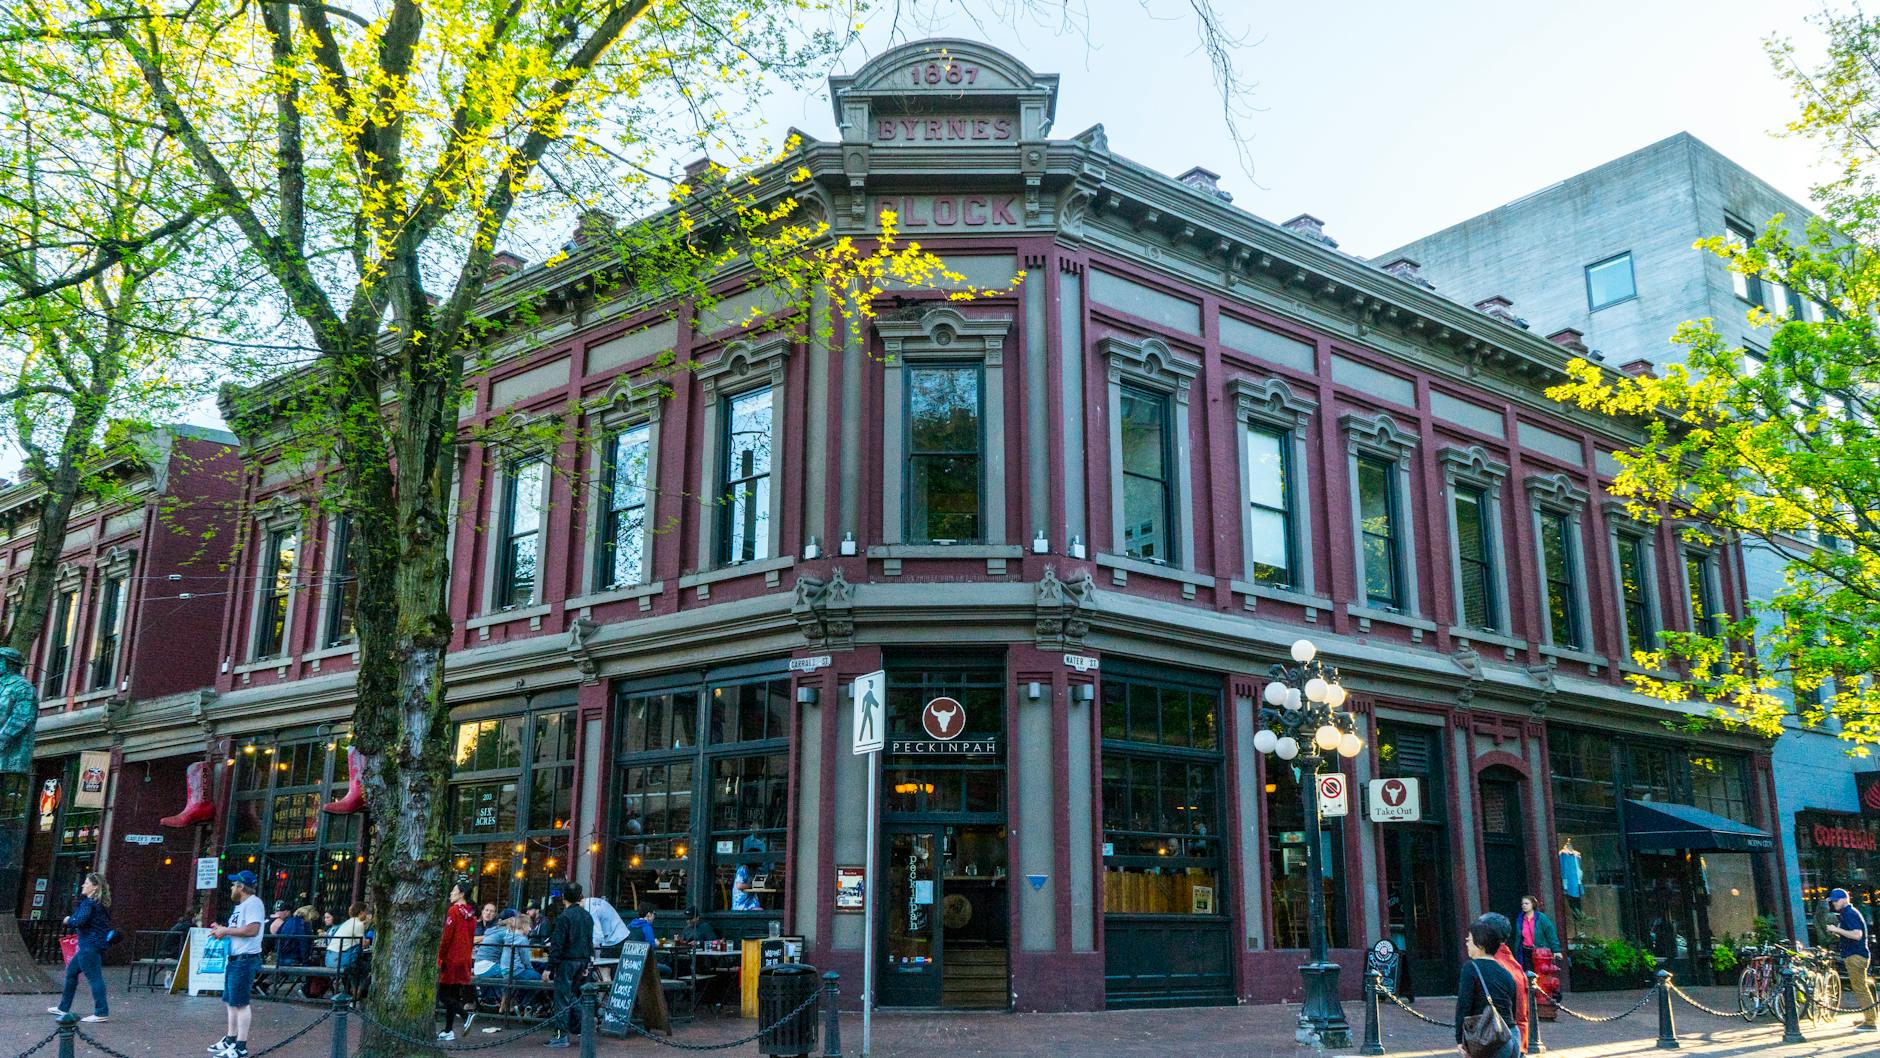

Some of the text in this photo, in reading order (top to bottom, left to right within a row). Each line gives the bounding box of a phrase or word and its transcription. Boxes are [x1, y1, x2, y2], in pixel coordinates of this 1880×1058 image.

[911, 63, 978, 84] 1887
[877, 118, 1012, 141] BYRNES
[874, 196, 1017, 226] BLOCK
[1066, 656, 1083, 665] WATER
[893, 743, 995, 752] PECKINPAH
[480, 808, 492, 817] SIX
[1375, 807, 1412, 816] Take Out
[475, 817, 496, 825] ACRES
[622, 958, 642, 970] VEGANS
[618, 971, 634, 983] WITH
[613, 983, 633, 997] LOOSE
[609, 996, 632, 1010] MORALS
